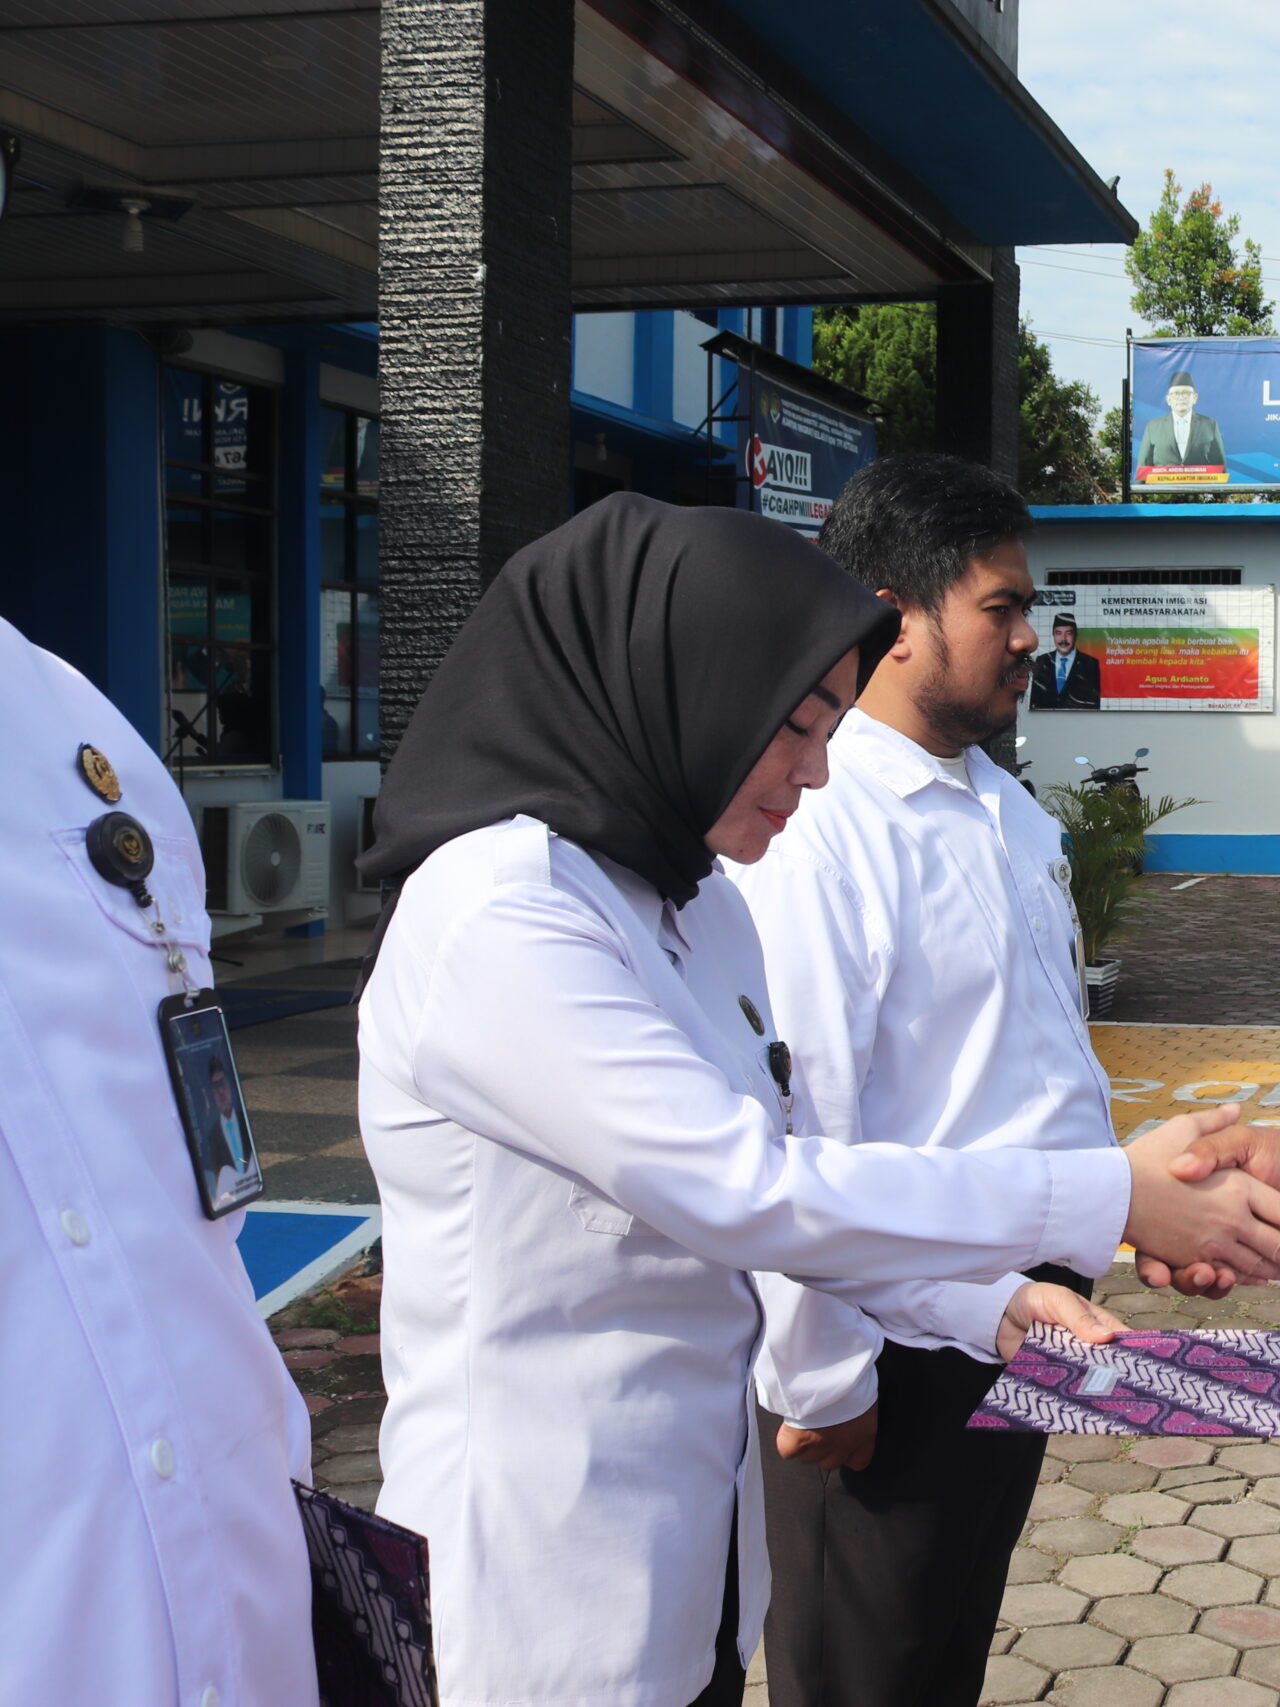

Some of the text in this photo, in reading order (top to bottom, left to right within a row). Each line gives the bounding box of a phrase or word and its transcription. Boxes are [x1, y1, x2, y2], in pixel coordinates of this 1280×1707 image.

[767, 449, 808, 486] AYO!!!
[1101, 597, 1208, 606] KEMENTERIAN IMIGRASI
[1103, 608, 1206, 616] DAN PEMASYARAKATAN
[1178, 648, 1201, 656] maka
[1145, 675, 1209, 685] Agus Ardianto
